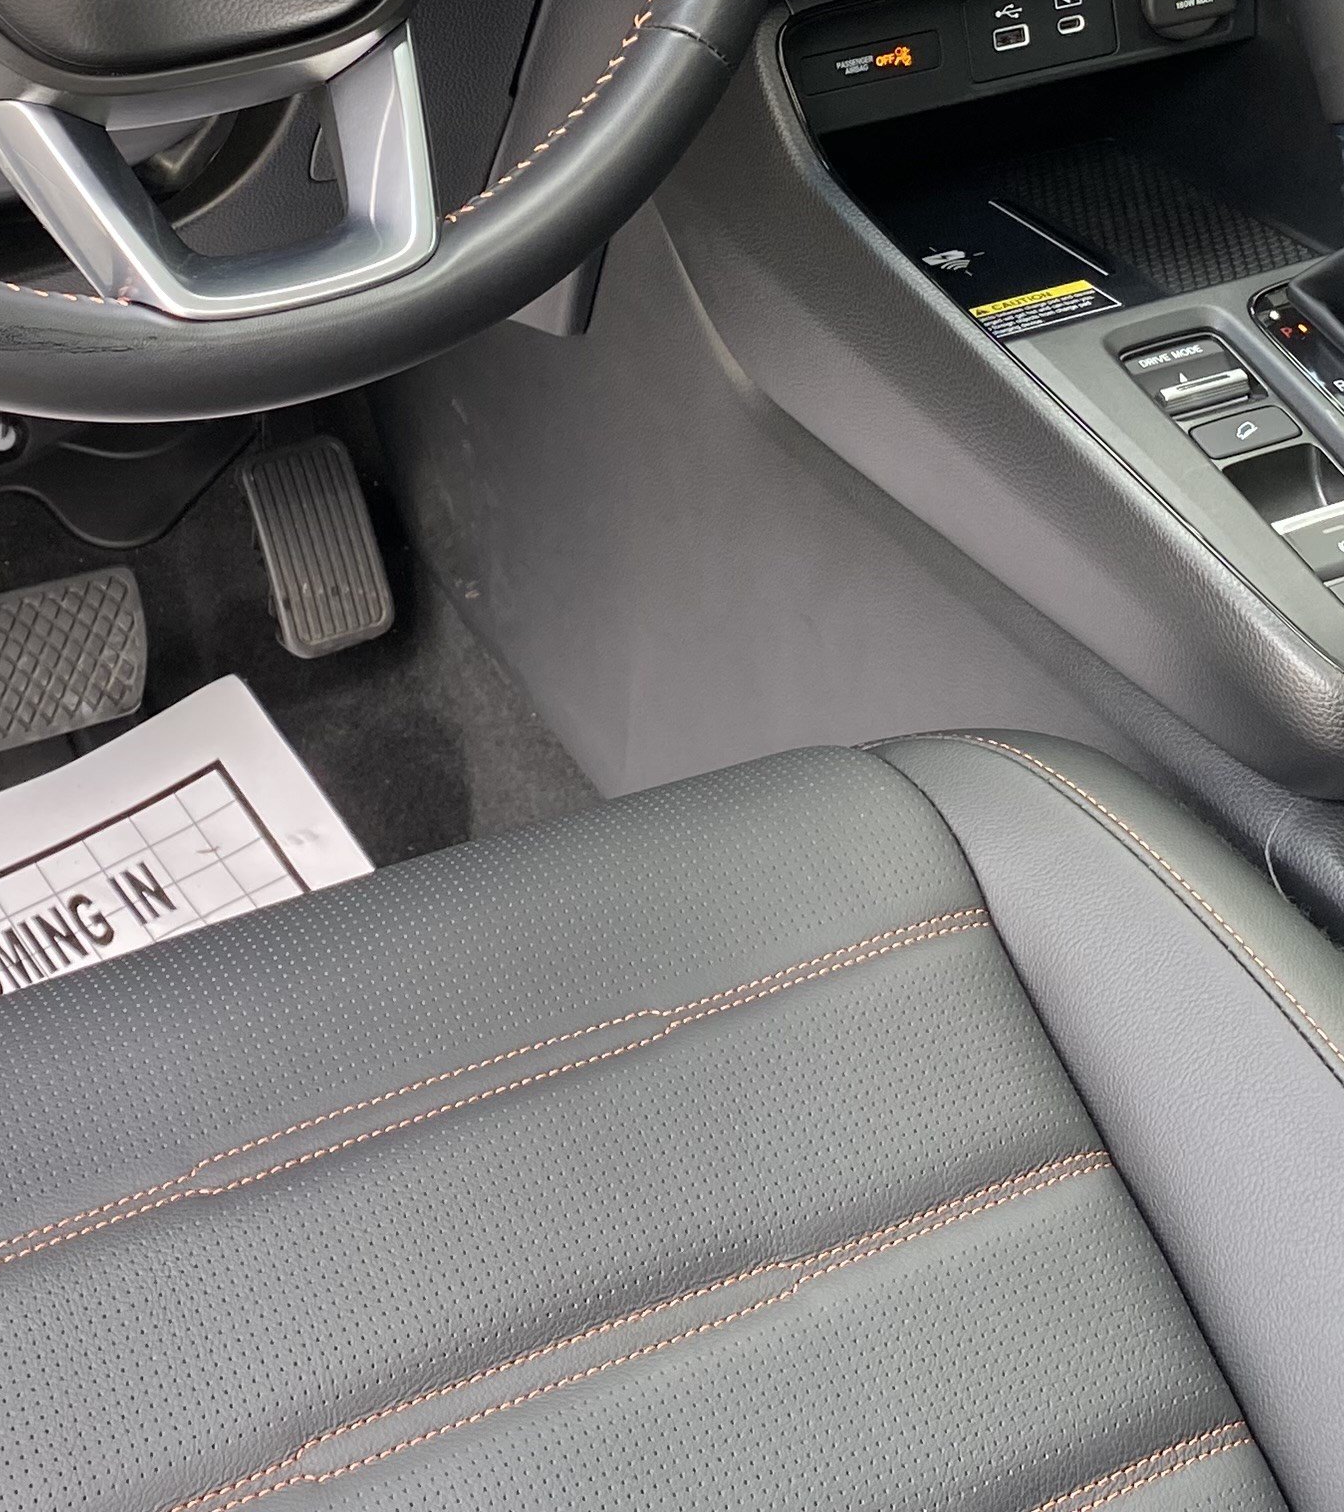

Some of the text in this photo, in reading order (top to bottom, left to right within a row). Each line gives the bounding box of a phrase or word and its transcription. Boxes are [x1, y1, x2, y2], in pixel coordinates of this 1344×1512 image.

[876, 53, 895, 67] OFF
[991, 291, 1052, 312] CAUTION
[1280, 326, 1293, 338] P
[1138, 344, 1203, 369] DRIVE MODE
[108, 861, 179, 925] IN
